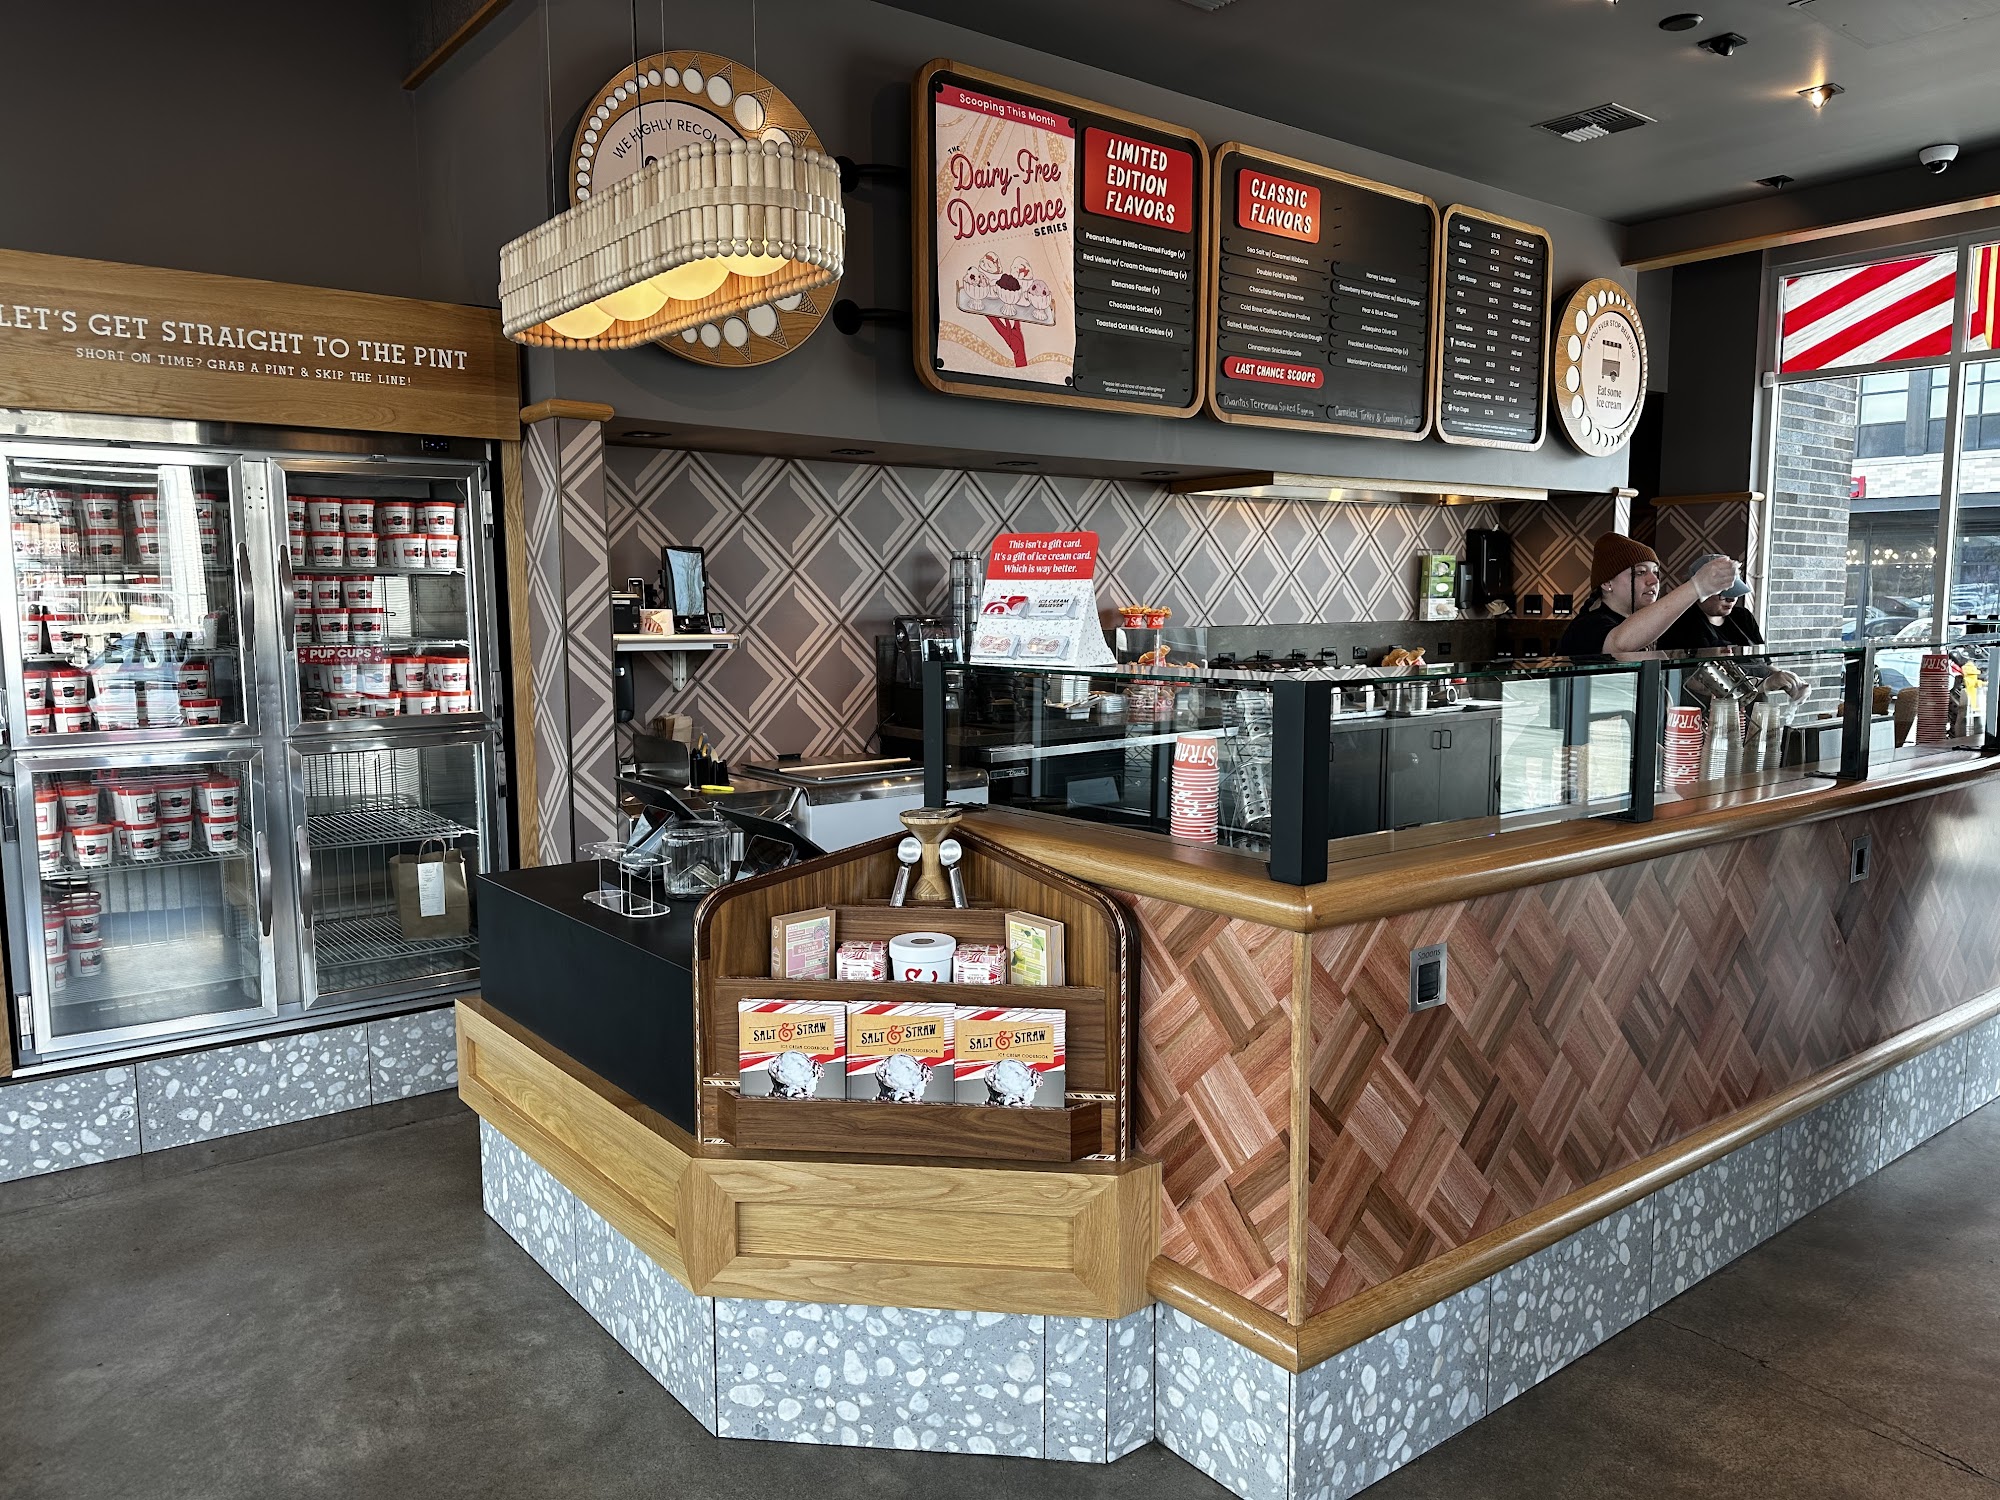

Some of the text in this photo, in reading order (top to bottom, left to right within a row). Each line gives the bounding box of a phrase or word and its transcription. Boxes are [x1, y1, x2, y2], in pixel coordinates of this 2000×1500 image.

[960, 93, 1056, 127] Scooping This Month
[613, 137, 632, 158] WE
[629, 119, 672, 142] HIGHLY
[948, 146, 960, 155] THE
[1107, 139, 1167, 171] LIMITED
[951, 149, 1061, 195] Dairy-Free
[1107, 164, 1167, 197] EDITION
[1251, 178, 1308, 208] CLASSIC
[947, 187, 1066, 240] Decadence
[1106, 191, 1175, 224] FLAVORS
[1251, 203, 1312, 234] FLAVORS
[1034, 222, 1067, 237] SERIES
[1086, 232, 1105, 242] Peanut
[1106, 236, 1122, 245] Butter
[1123, 240, 1138, 249] Brittle
[1138, 243, 1161, 254] Caramel
[1161, 248, 1177, 258] Fudge
[1247, 246, 1256, 254] Sea
[1083, 253, 1187, 280] Red Velvet w/ Cream Cheese Frosting (v)
[1257, 268, 1272, 277] Double
[1282, 273, 1297, 281] Vanilla
[1112, 280, 1160, 295] Bananas Foster (v)
[1249, 286, 1272, 295] Chocolate
[1287, 293, 1304, 301] Brownie
[1109, 301, 1162, 316] Chocolate Sorbet (v)
[1296, 313, 1310, 321] Praline
[0, 304, 467, 370] LET'S GET STRAIGHT TO THE PINT
[1096, 319, 1117, 328] Toasted
[1129, 324, 1139, 332] Milk
[1145, 327, 1164, 335] Cookies
[1165, 329, 1173, 338] (v)
[1260, 326, 1282, 335] Chocolate
[1283, 330, 1293, 338] Chip
[1293, 331, 1308, 339] Cookie
[1309, 334, 1322, 342] Dough
[1590, 330, 1598, 341] YOU
[1599, 320, 1609, 331] EVER
[1610, 320, 1621, 328] STOP
[1248, 343, 1301, 356] Cinnamon Snickerdoodle
[76, 348, 411, 386] SHORT ON TIME? GRAB A PINT & SKIP THE LINE!
[1236, 363, 1316, 383] LAST CHANCE SCOOPS
[1598, 385, 1621, 398] Eat some
[1605, 401, 1621, 410] cream
[1009, 540, 1024, 548] This
[1025, 540, 1041, 548] isn't
[1048, 539, 1061, 550] gift
[1063, 539, 1082, 548] card.
[994, 552, 1006, 560] It's
[1013, 552, 1026, 562] gift
[1027, 552, 1036, 561] of
[1036, 552, 1046, 560] ice
[1073, 551, 1091, 559] card.
[1004, 564, 1077, 574] Which is way better.
[310, 649, 371, 659] PUP CUPS
[1418, 949, 1440, 961] Spoons
[754, 1022, 826, 1041] SALT & STRAW
[861, 1024, 936, 1044] SALT & STRAW
[970, 1030, 1045, 1050] SALT & STRAW
